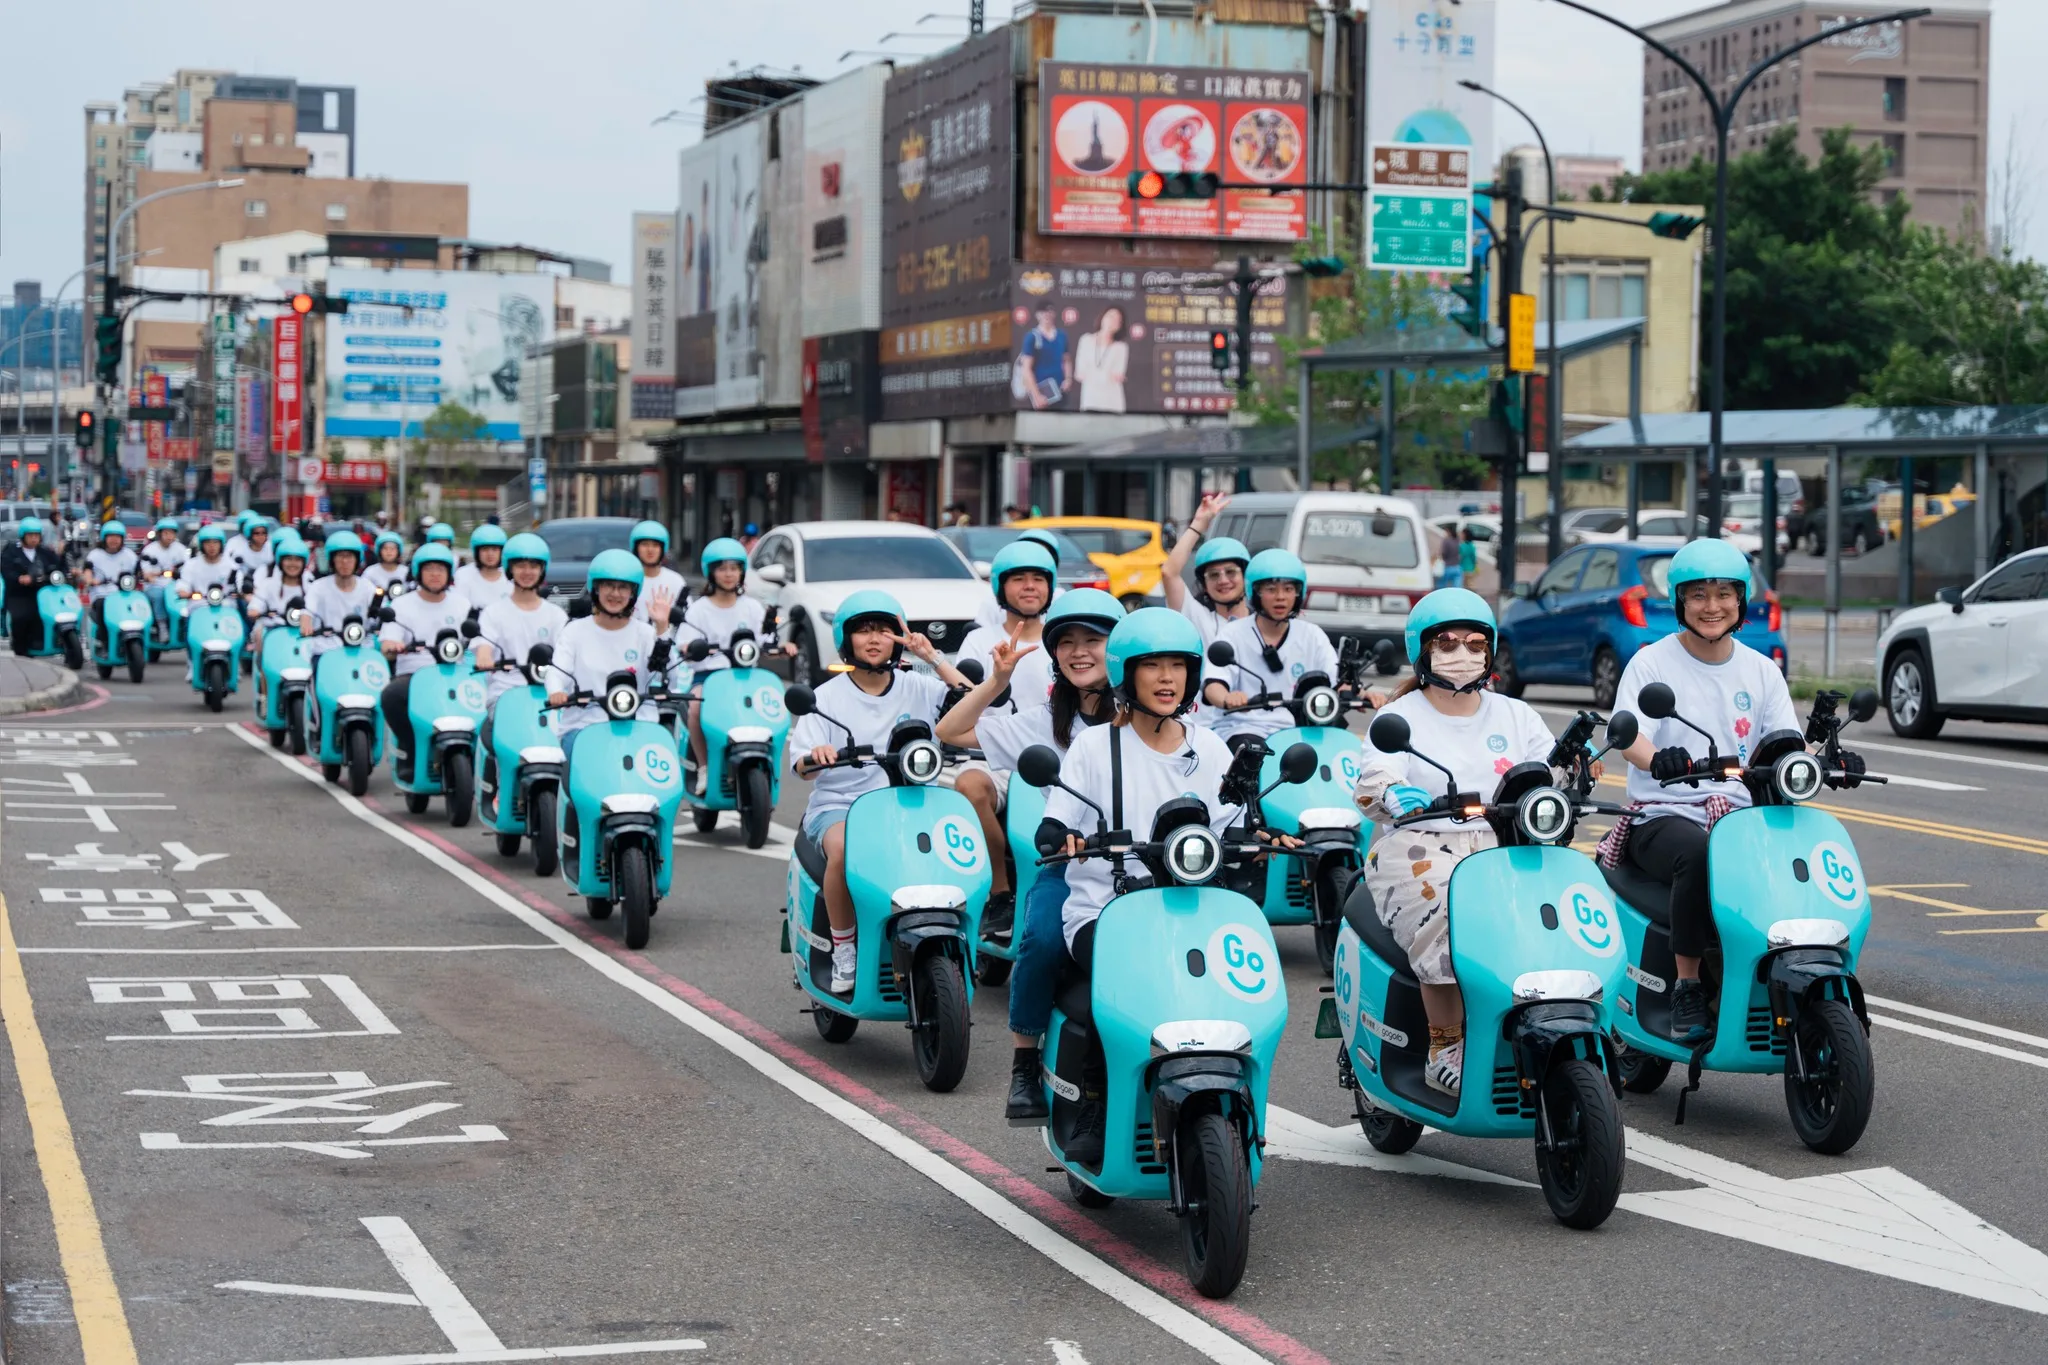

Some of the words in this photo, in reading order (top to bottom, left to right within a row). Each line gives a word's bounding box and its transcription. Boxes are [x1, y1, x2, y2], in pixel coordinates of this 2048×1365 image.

[1389, 150, 1467, 172] 城隍廟
[1490, 737, 1504, 747] Go
[646, 749, 671, 773] Go
[943, 822, 975, 853] Go
[1822, 848, 1855, 884] Go
[1572, 892, 1609, 930] Go
[1223, 932, 1265, 974] Go
[1336, 942, 1352, 1006] Go
[1640, 974, 1661, 988] gogoro
[1381, 1026, 1403, 1042] gogoro
[1055, 1080, 1075, 1096] gogoro
